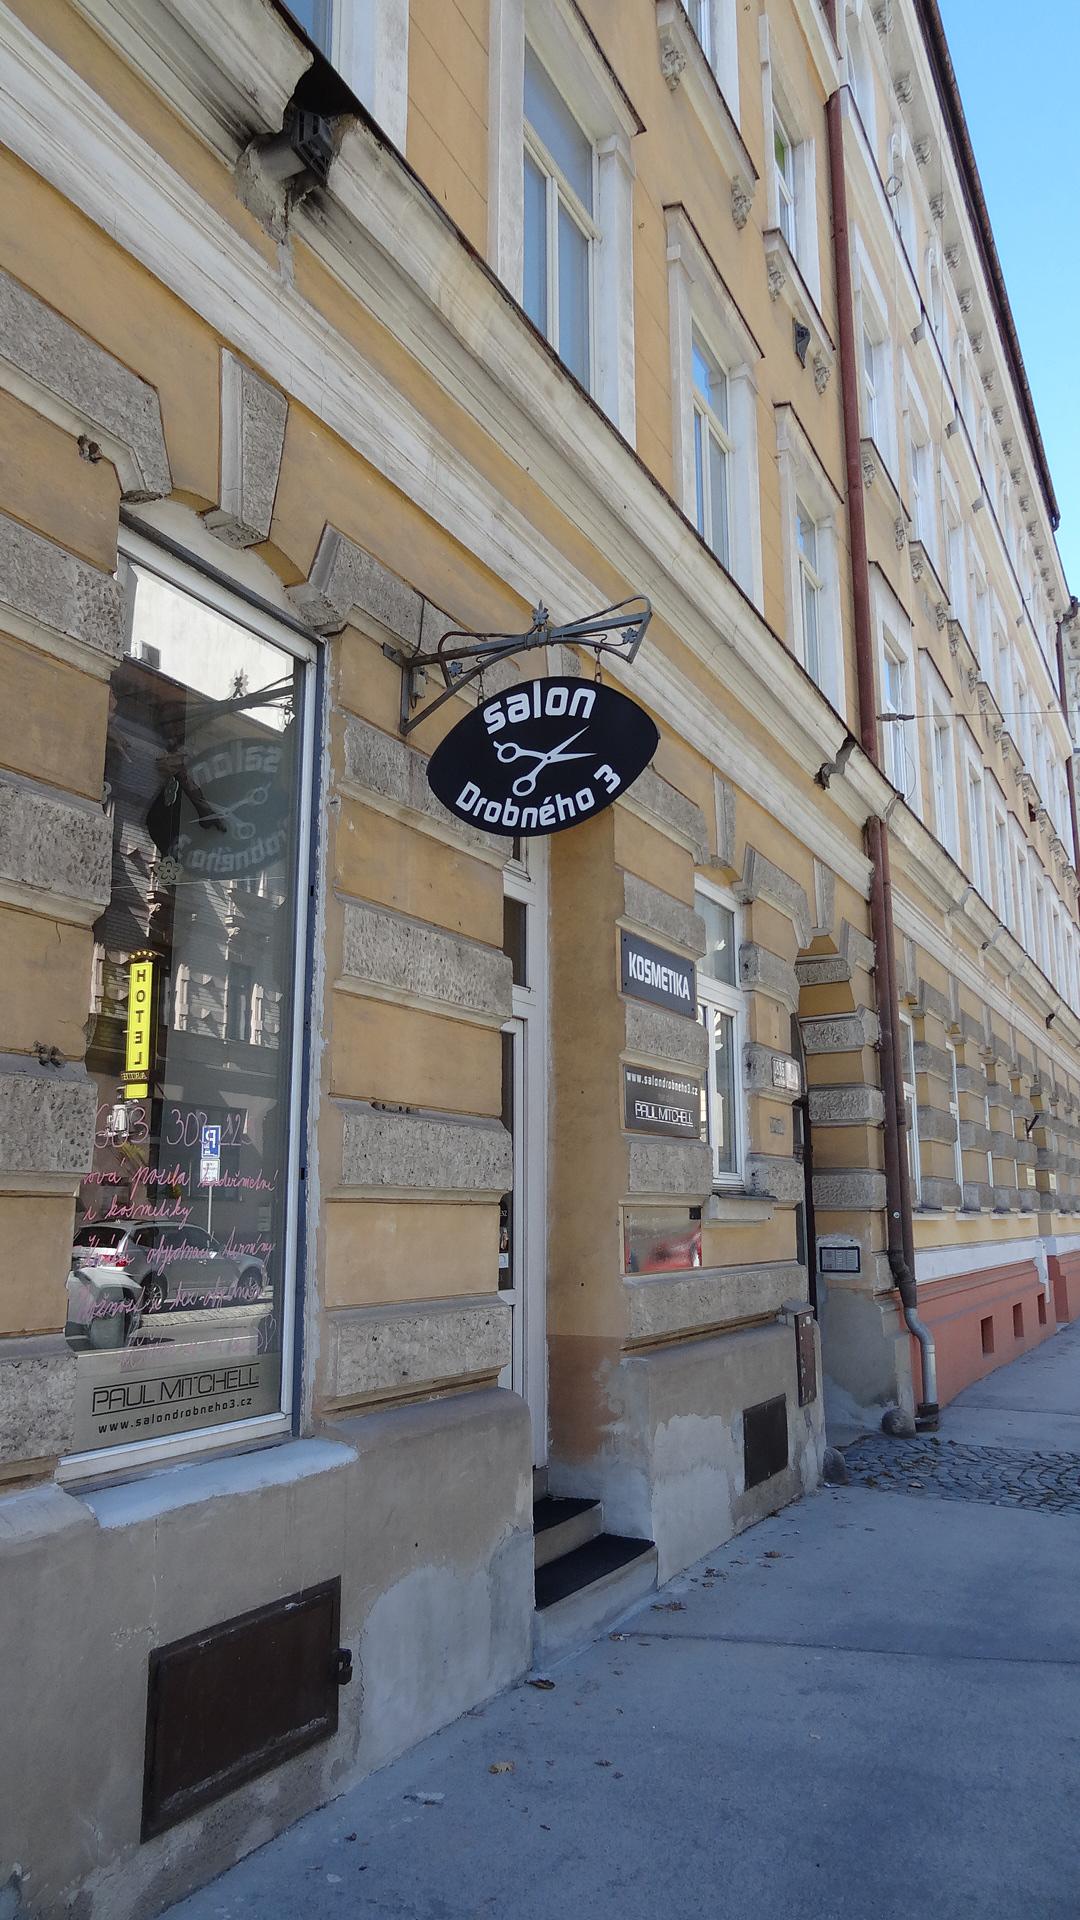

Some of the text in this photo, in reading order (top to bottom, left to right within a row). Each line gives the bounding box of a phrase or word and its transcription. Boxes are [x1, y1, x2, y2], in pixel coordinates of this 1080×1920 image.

[483, 680, 597, 735] salon
[456, 764, 622, 828] Drobného 3
[628, 951, 691, 1001] KOSMETIKA
[626, 1071, 698, 1096] www.salondrobneho3.cz
[635, 1103, 694, 1124] PAUL MITCHELL
[92, 1368, 259, 1412] PAUL MITCHELL
[98, 1397, 253, 1434] www.salondrobneho3.cz
